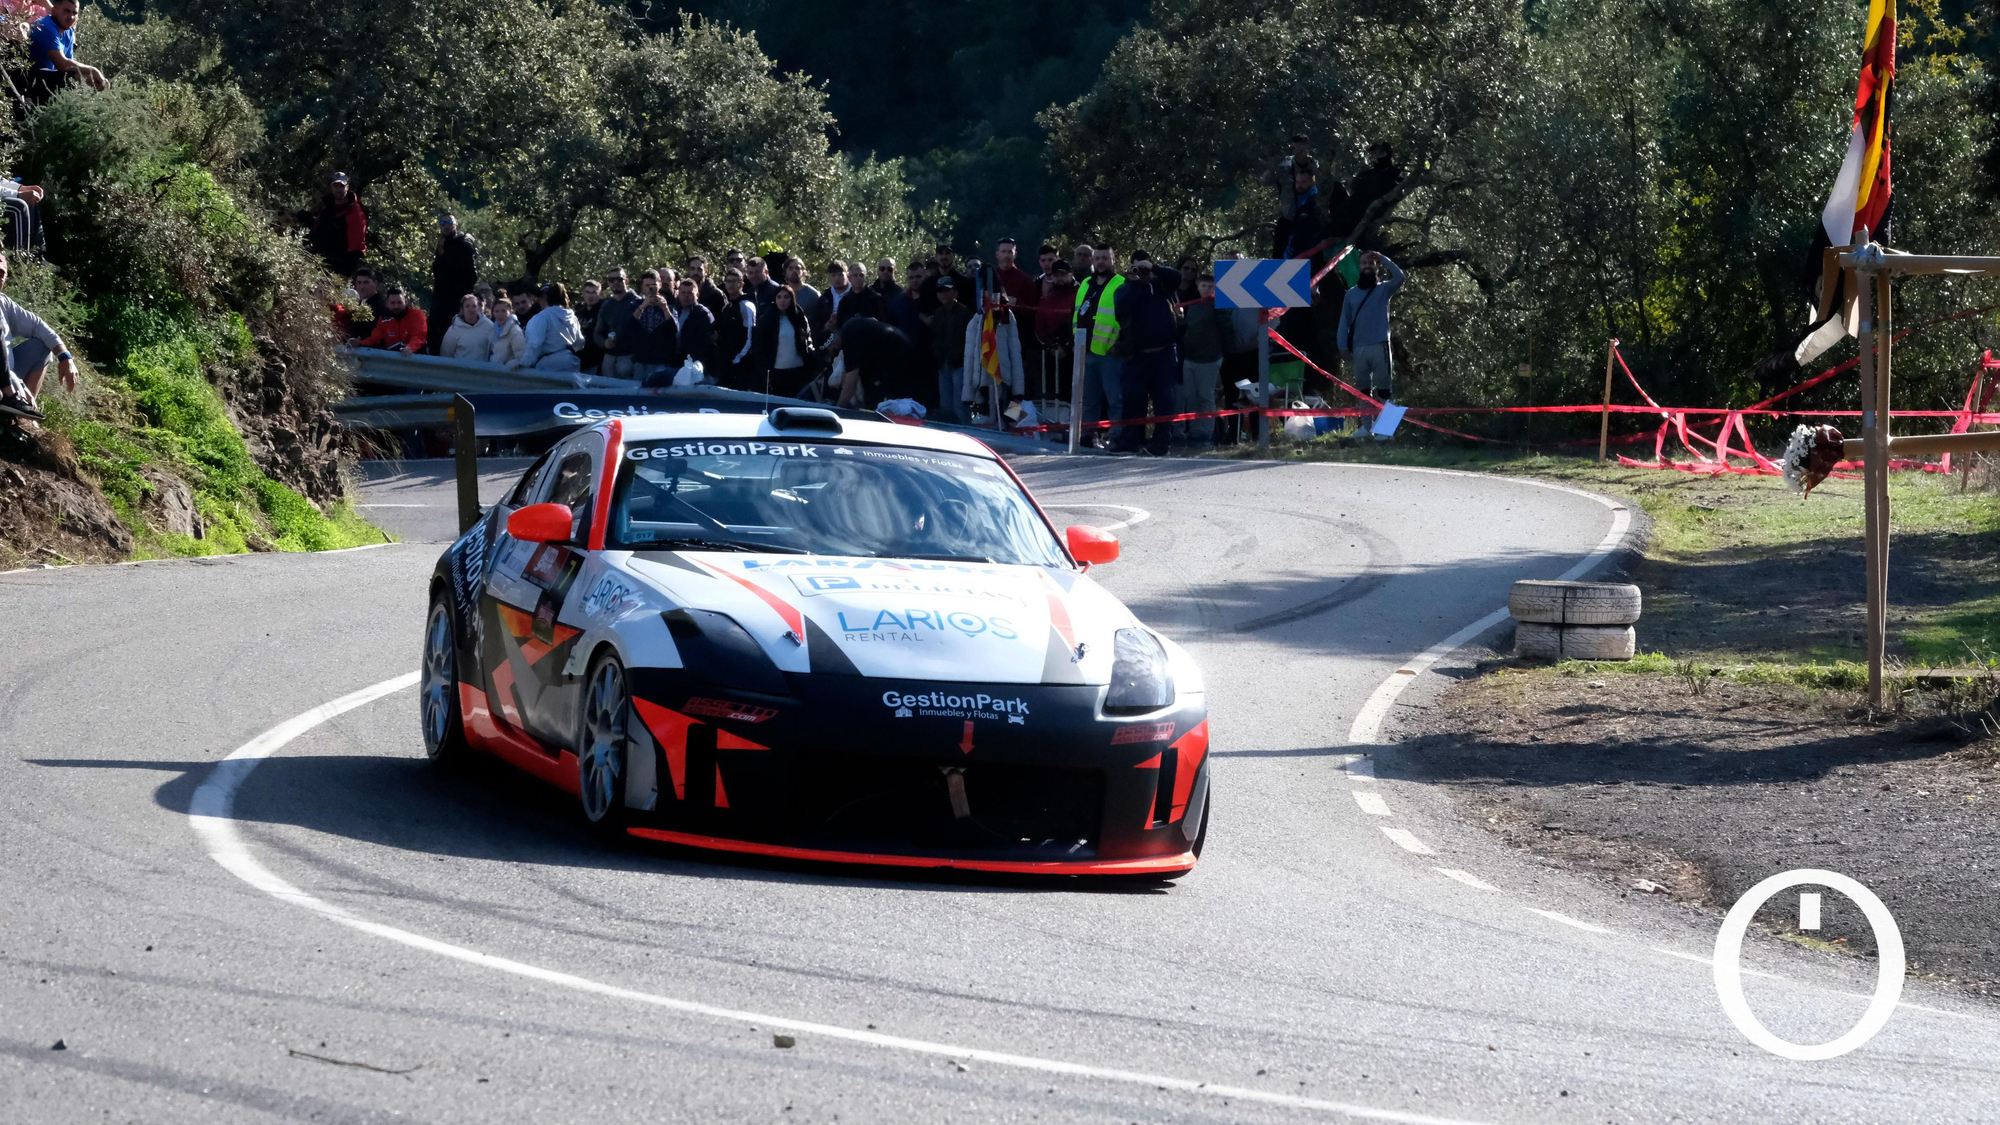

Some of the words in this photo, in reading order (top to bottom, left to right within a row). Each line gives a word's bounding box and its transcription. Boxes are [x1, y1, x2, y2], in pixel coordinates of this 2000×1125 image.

[626, 442, 819, 461] GestionPark
[862, 450, 920, 463] Inmuebles
[922, 457, 930, 465] y
[930, 458, 964, 470] Flotas
[837, 607, 1018, 642] LARIOS
[844, 631, 924, 643] RENTAL
[882, 690, 1029, 715] GestionPark
[919, 708, 965, 717] Inmuebles
[966, 710, 973, 719] y
[973, 710, 999, 720] Flotas
